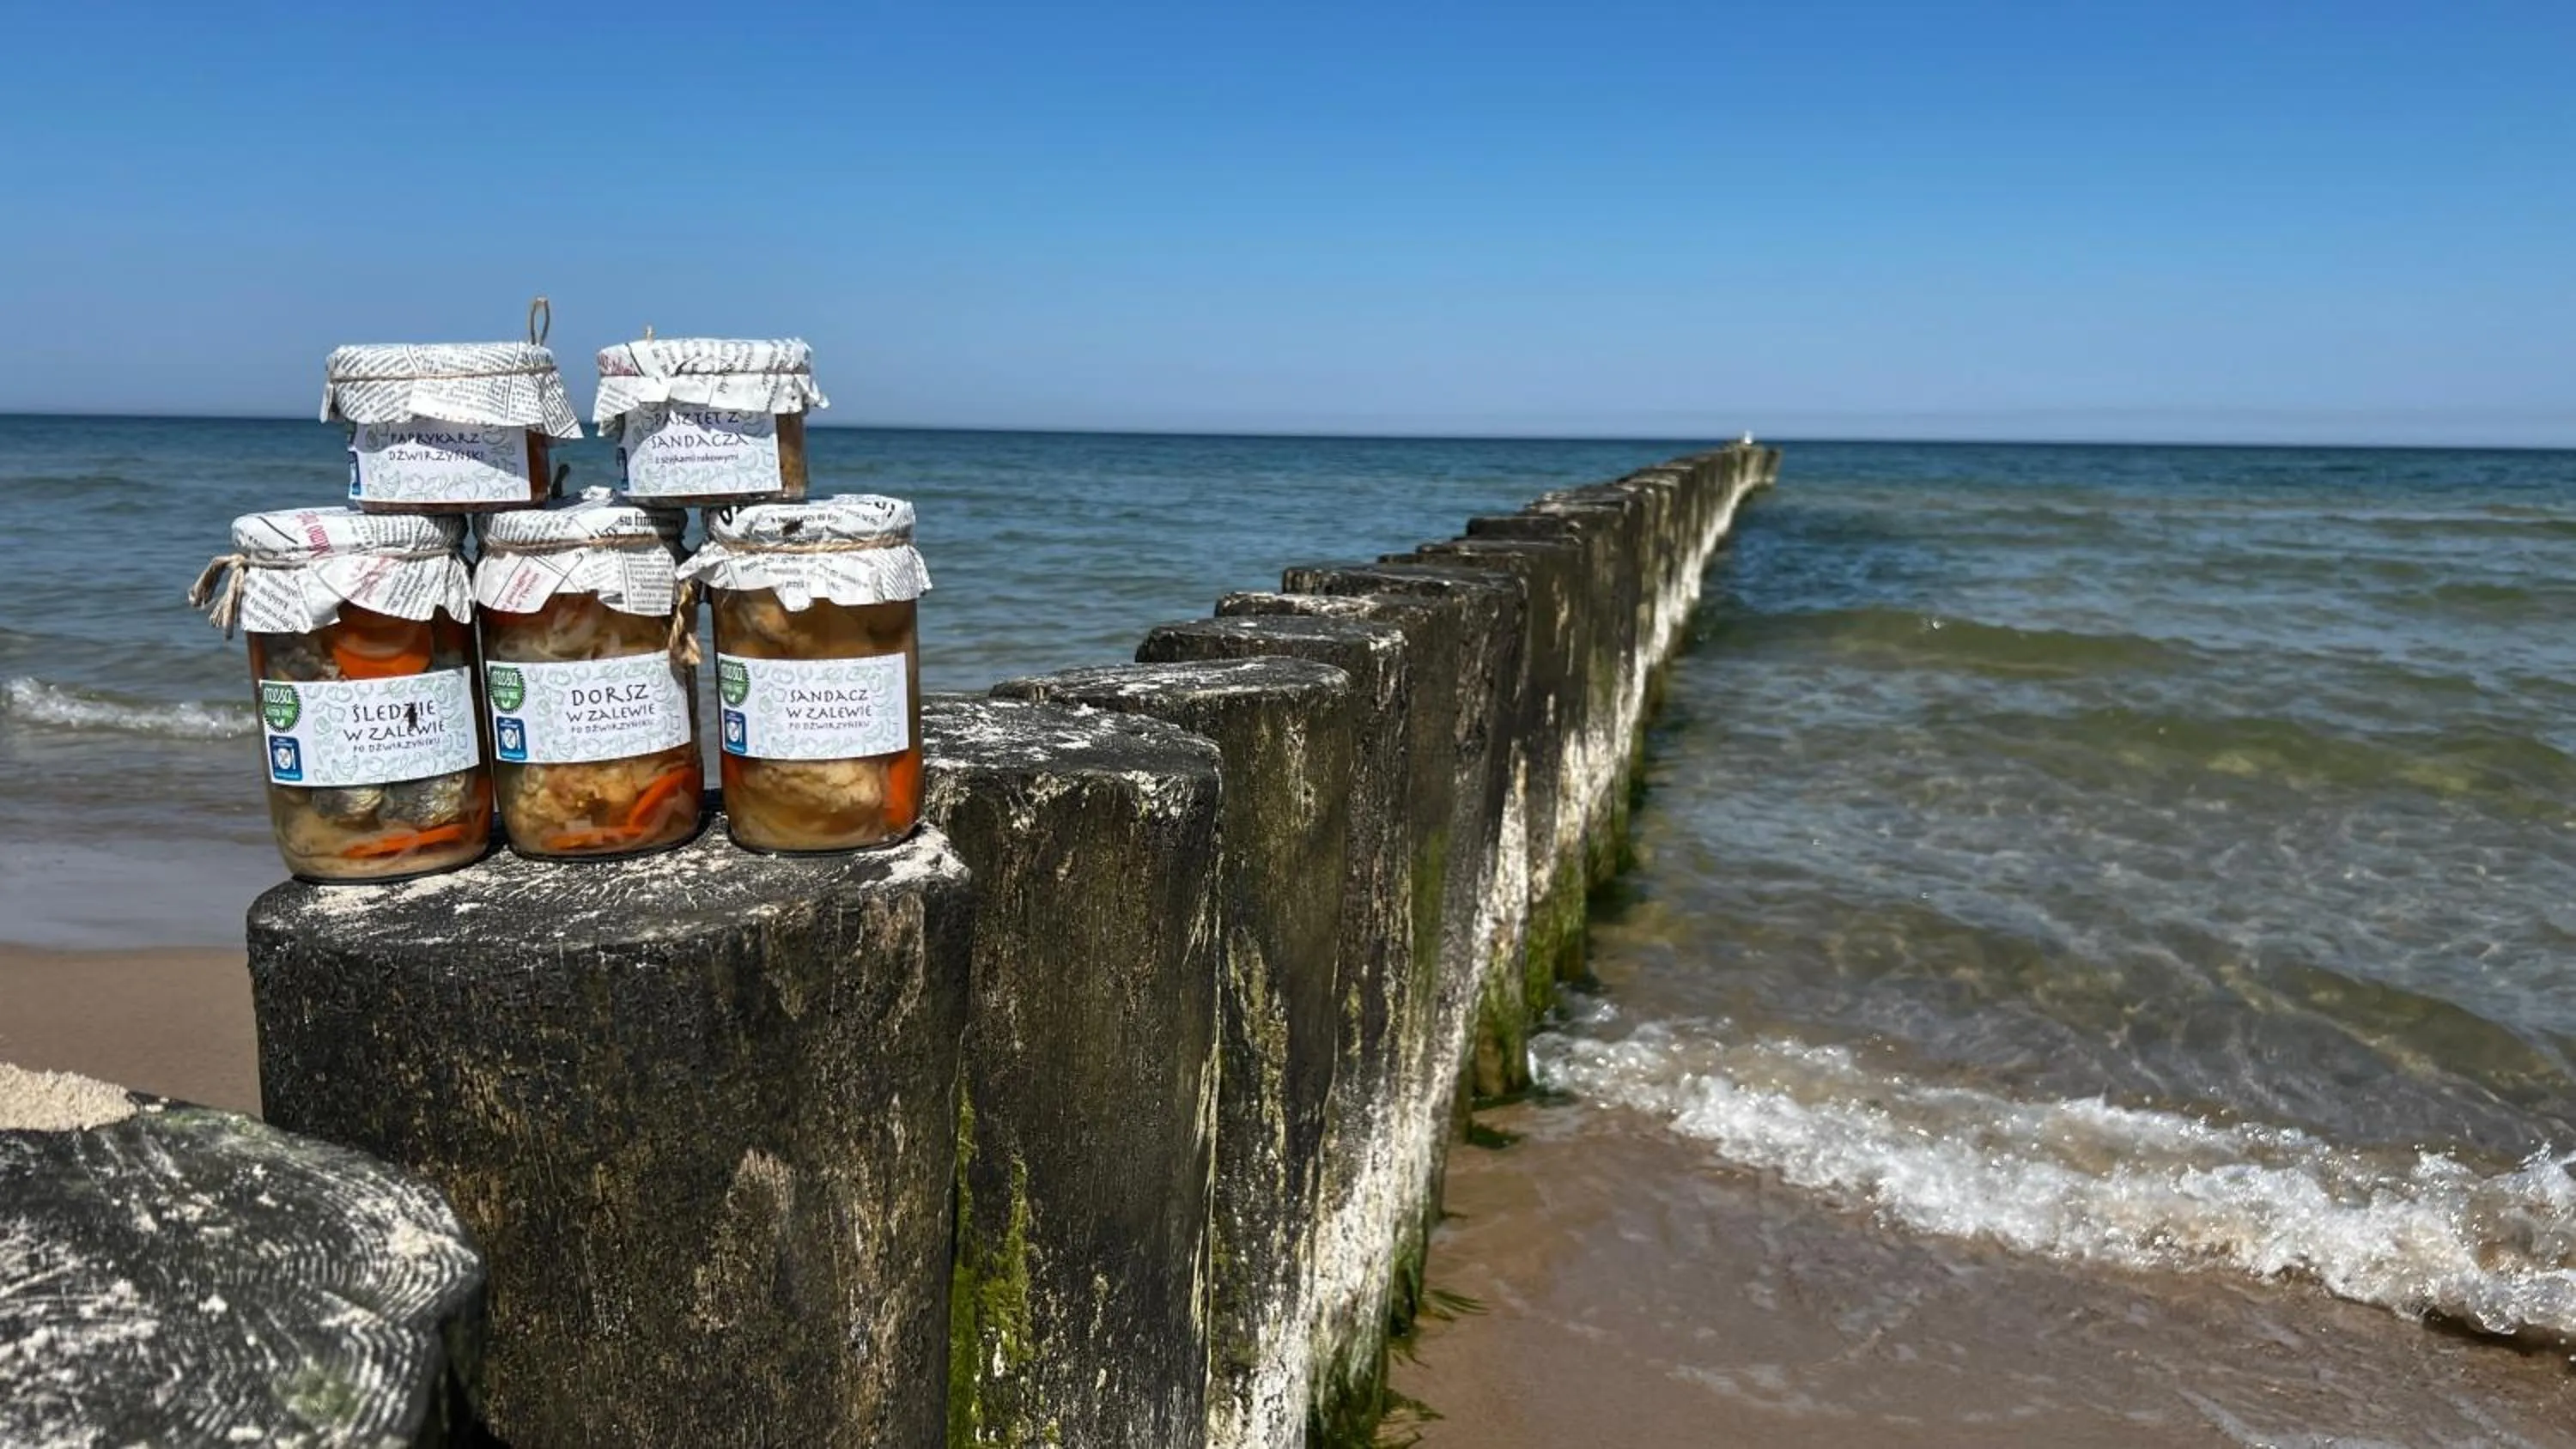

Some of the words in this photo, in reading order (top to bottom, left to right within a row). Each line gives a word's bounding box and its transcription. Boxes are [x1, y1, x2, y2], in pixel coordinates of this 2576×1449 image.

[654, 411, 721, 427] PASZTET
[727, 411, 739, 423] Z
[391, 432, 481, 445] PAPRYKARZ
[649, 432, 750, 450] SANDACZA
[572, 684, 649, 706] DORSZ
[790, 689, 869, 704] SANDACZ
[352, 700, 436, 724] ŚLEDZIE
[566, 711, 583, 723] W
[587, 703, 657, 723] ZALEWIE
[786, 706, 801, 718] W
[806, 705, 872, 720] ZALEWIE
[343, 729, 363, 742] W
[368, 719, 446, 741] ZALEWIE
